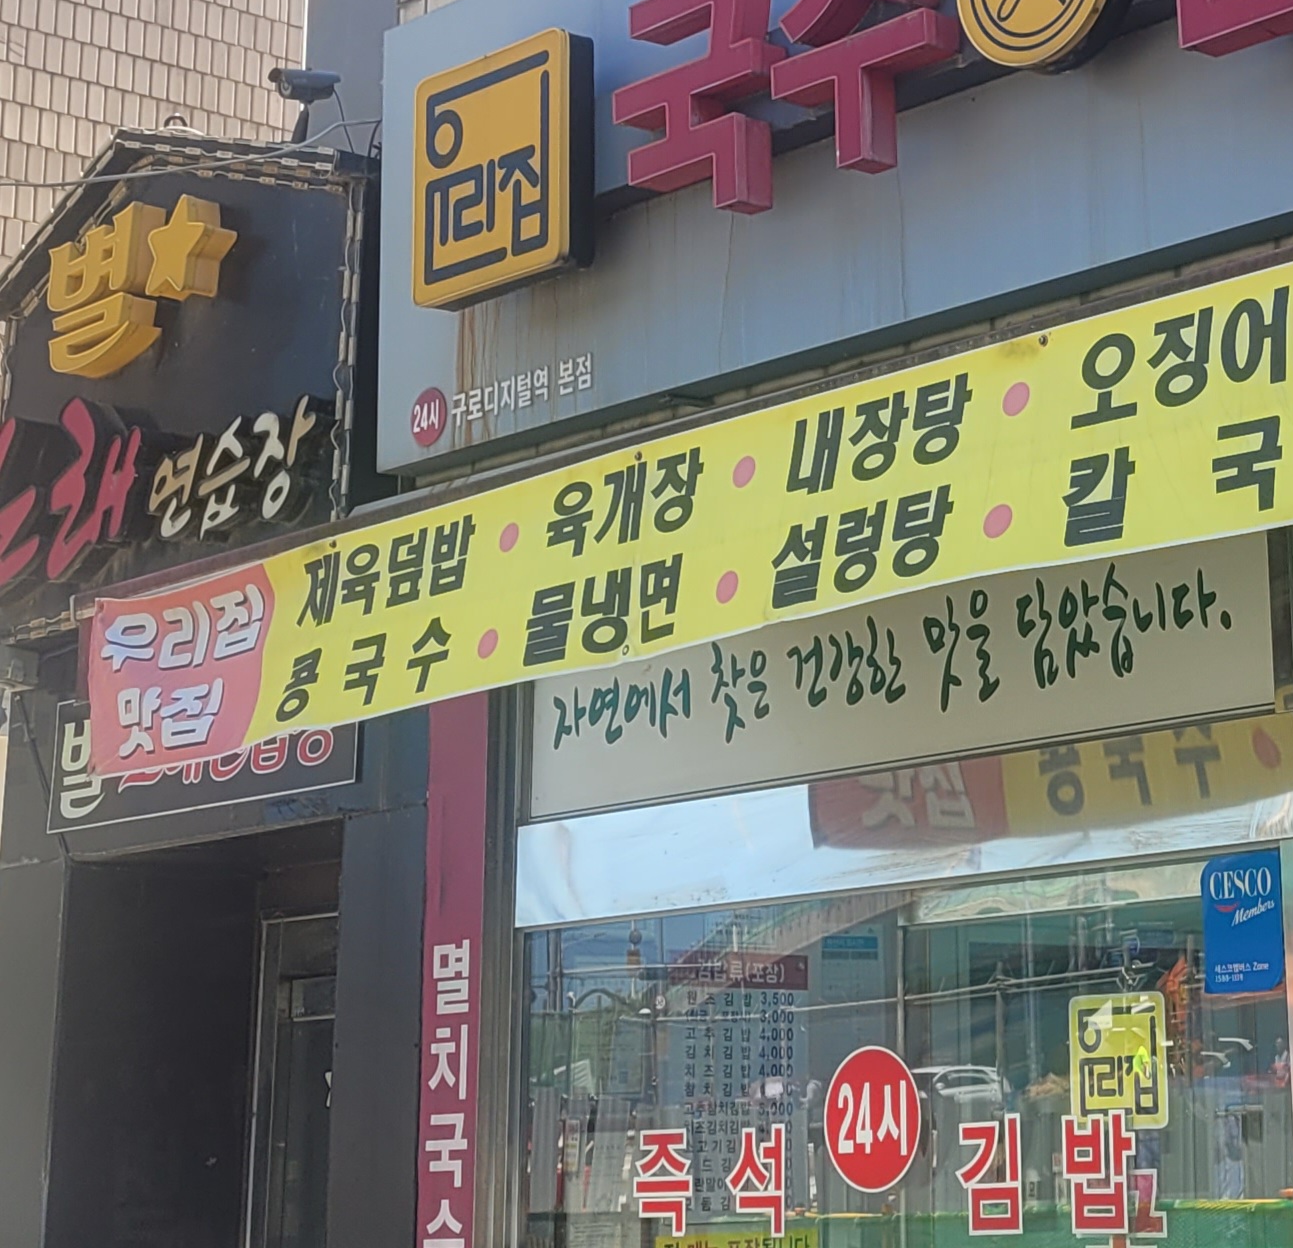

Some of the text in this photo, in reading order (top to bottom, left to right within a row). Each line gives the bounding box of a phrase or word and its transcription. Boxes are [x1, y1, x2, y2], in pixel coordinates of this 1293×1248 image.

[48, 200, 164, 379] 별
[413, 352, 592, 434] 24시 구로디지털역 본점
[148, 395, 317, 540] 연습장
[296, 514, 476, 628] 제육덮밥
[545, 447, 704, 558] 육개장
[785, 372, 973, 496] 내장탕
[101, 583, 264, 672] 우리집
[274, 616, 452, 723] 콩국수
[522, 553, 683, 668] 물냉면
[770, 484, 955, 610] 설렁탕
[553, 561, 1233, 750] 자연에서 찾은 건강한 맛을 담았습니다.
[117, 677, 225, 759] 맛집
[1209, 866, 1272, 901] CESCO
[1231, 897, 1275, 927] Members
[760, 991, 795, 1007] 3,500
[684, 1064, 751, 1079] 치즈김밥
[837, 1078, 908, 1156] 24시
[633, 1108, 1137, 1238] 즉석 김밥
